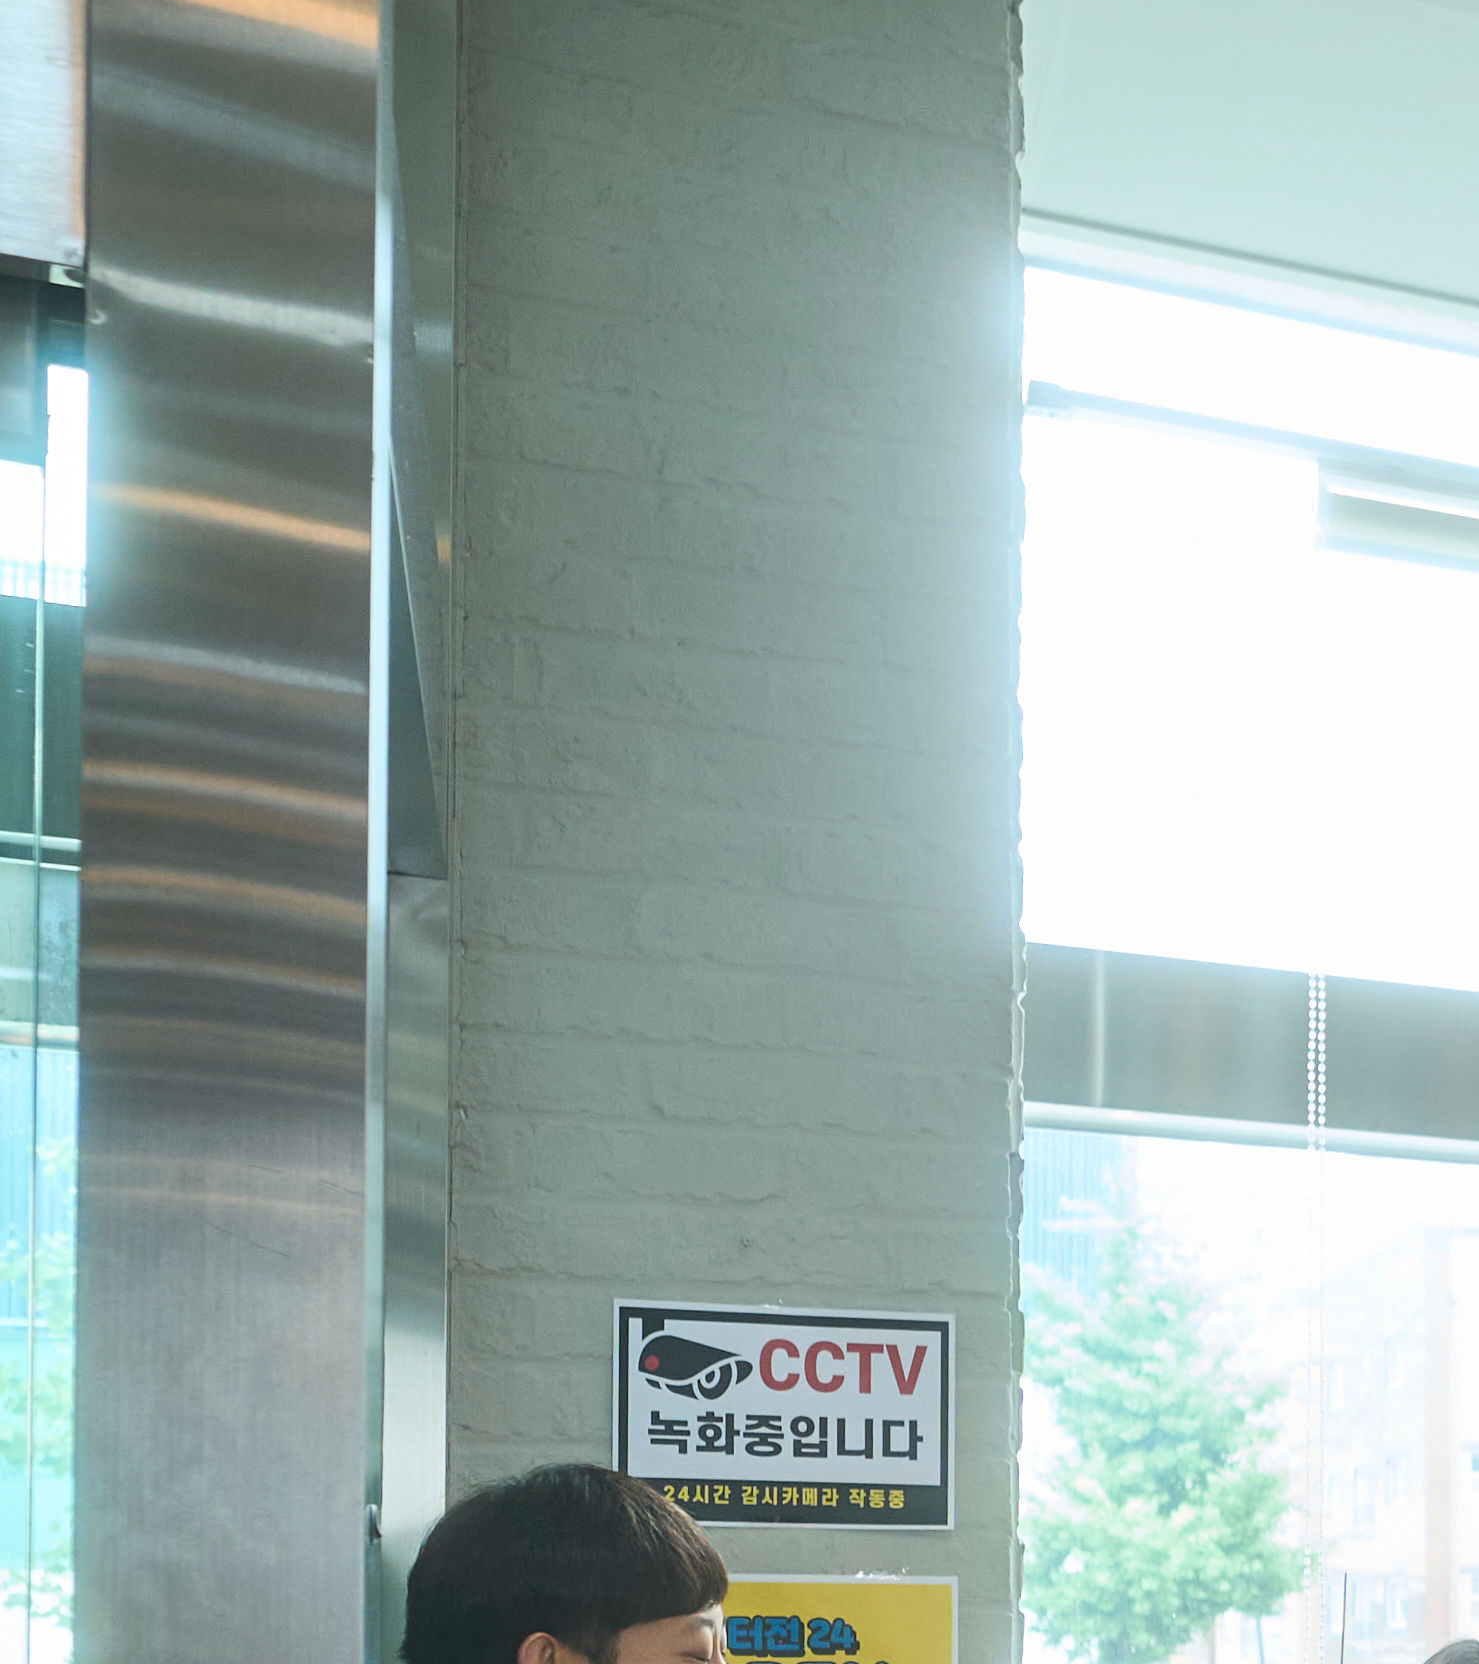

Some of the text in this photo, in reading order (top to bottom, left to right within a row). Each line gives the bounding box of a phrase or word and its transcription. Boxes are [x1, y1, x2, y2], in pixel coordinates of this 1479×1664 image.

[758, 1339, 928, 1396] CCTV
[647, 1410, 924, 1461] 녹화중입니다
[664, 1484, 906, 1509] 24시간 감시카메라 작동중
[726, 1615, 860, 1657] 터전 24
